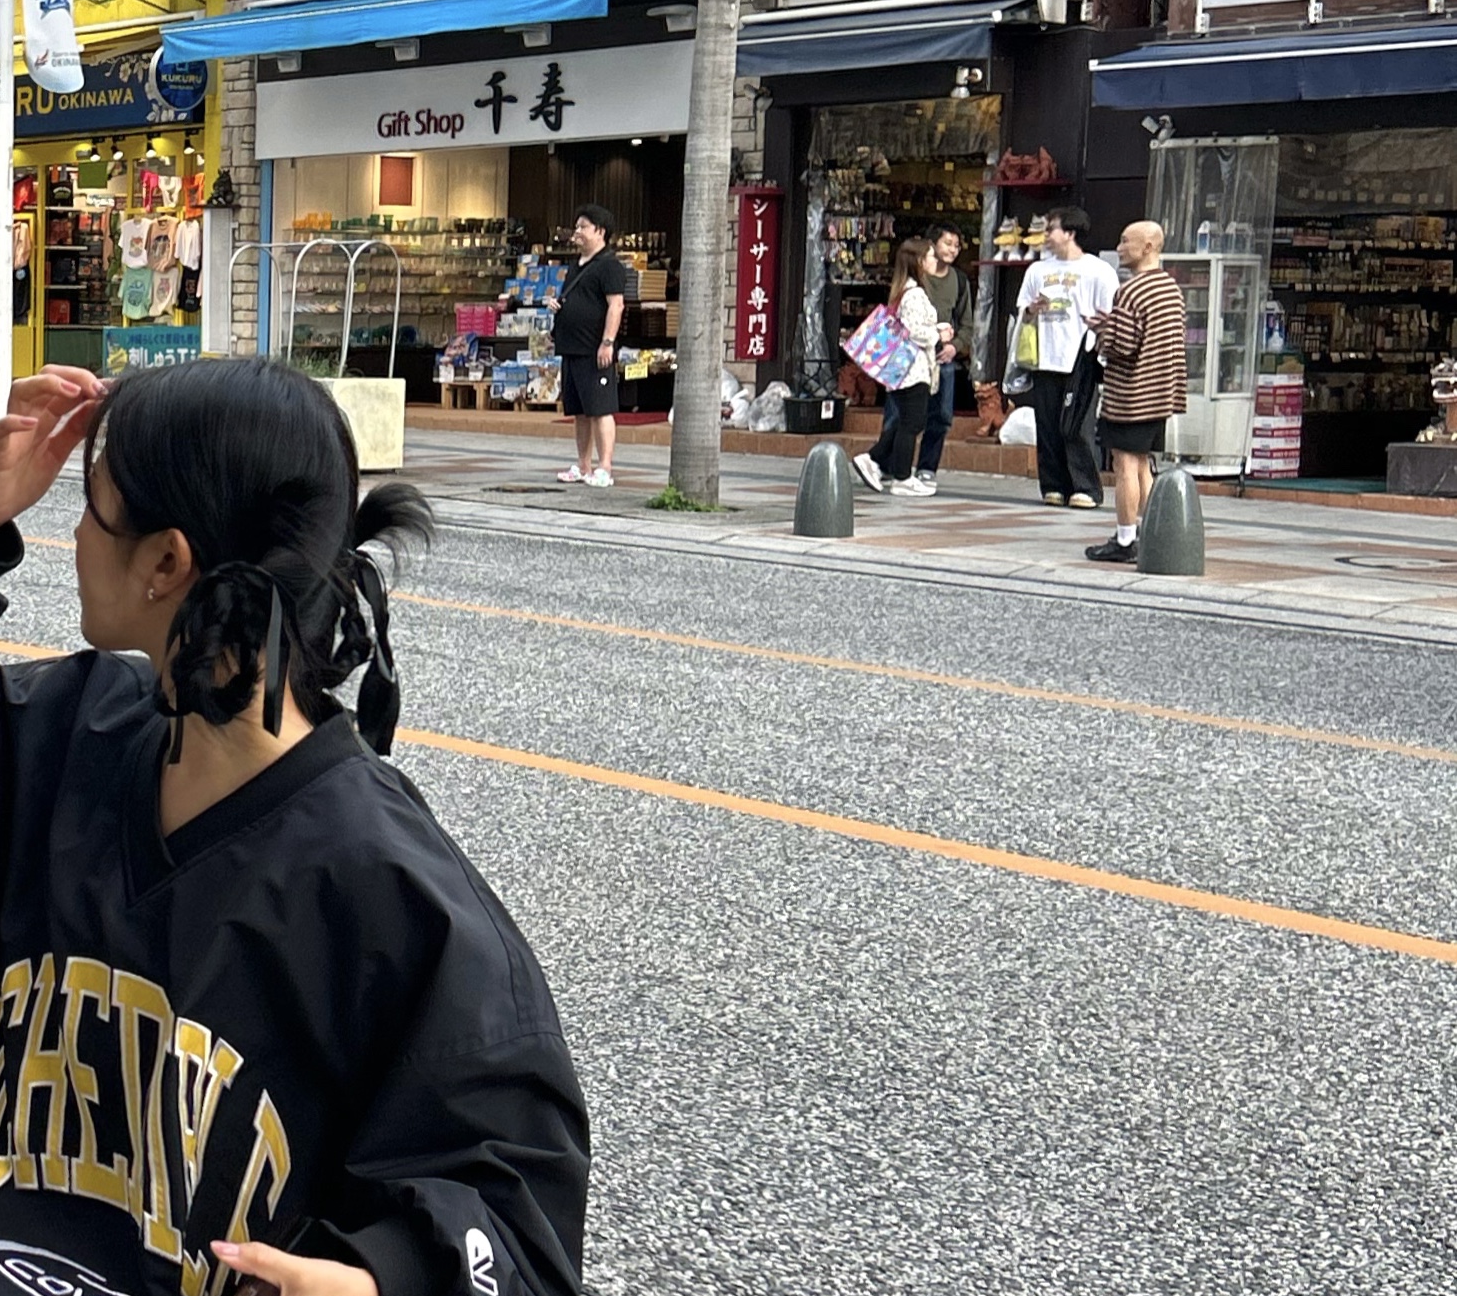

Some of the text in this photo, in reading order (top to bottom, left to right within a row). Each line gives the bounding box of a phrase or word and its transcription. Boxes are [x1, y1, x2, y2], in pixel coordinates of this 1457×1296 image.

[58, 88, 135, 111] OKINAWA
[377, 61, 576, 139] Gift Shop 千寿
[746, 198, 769, 356] シーサー専門店
